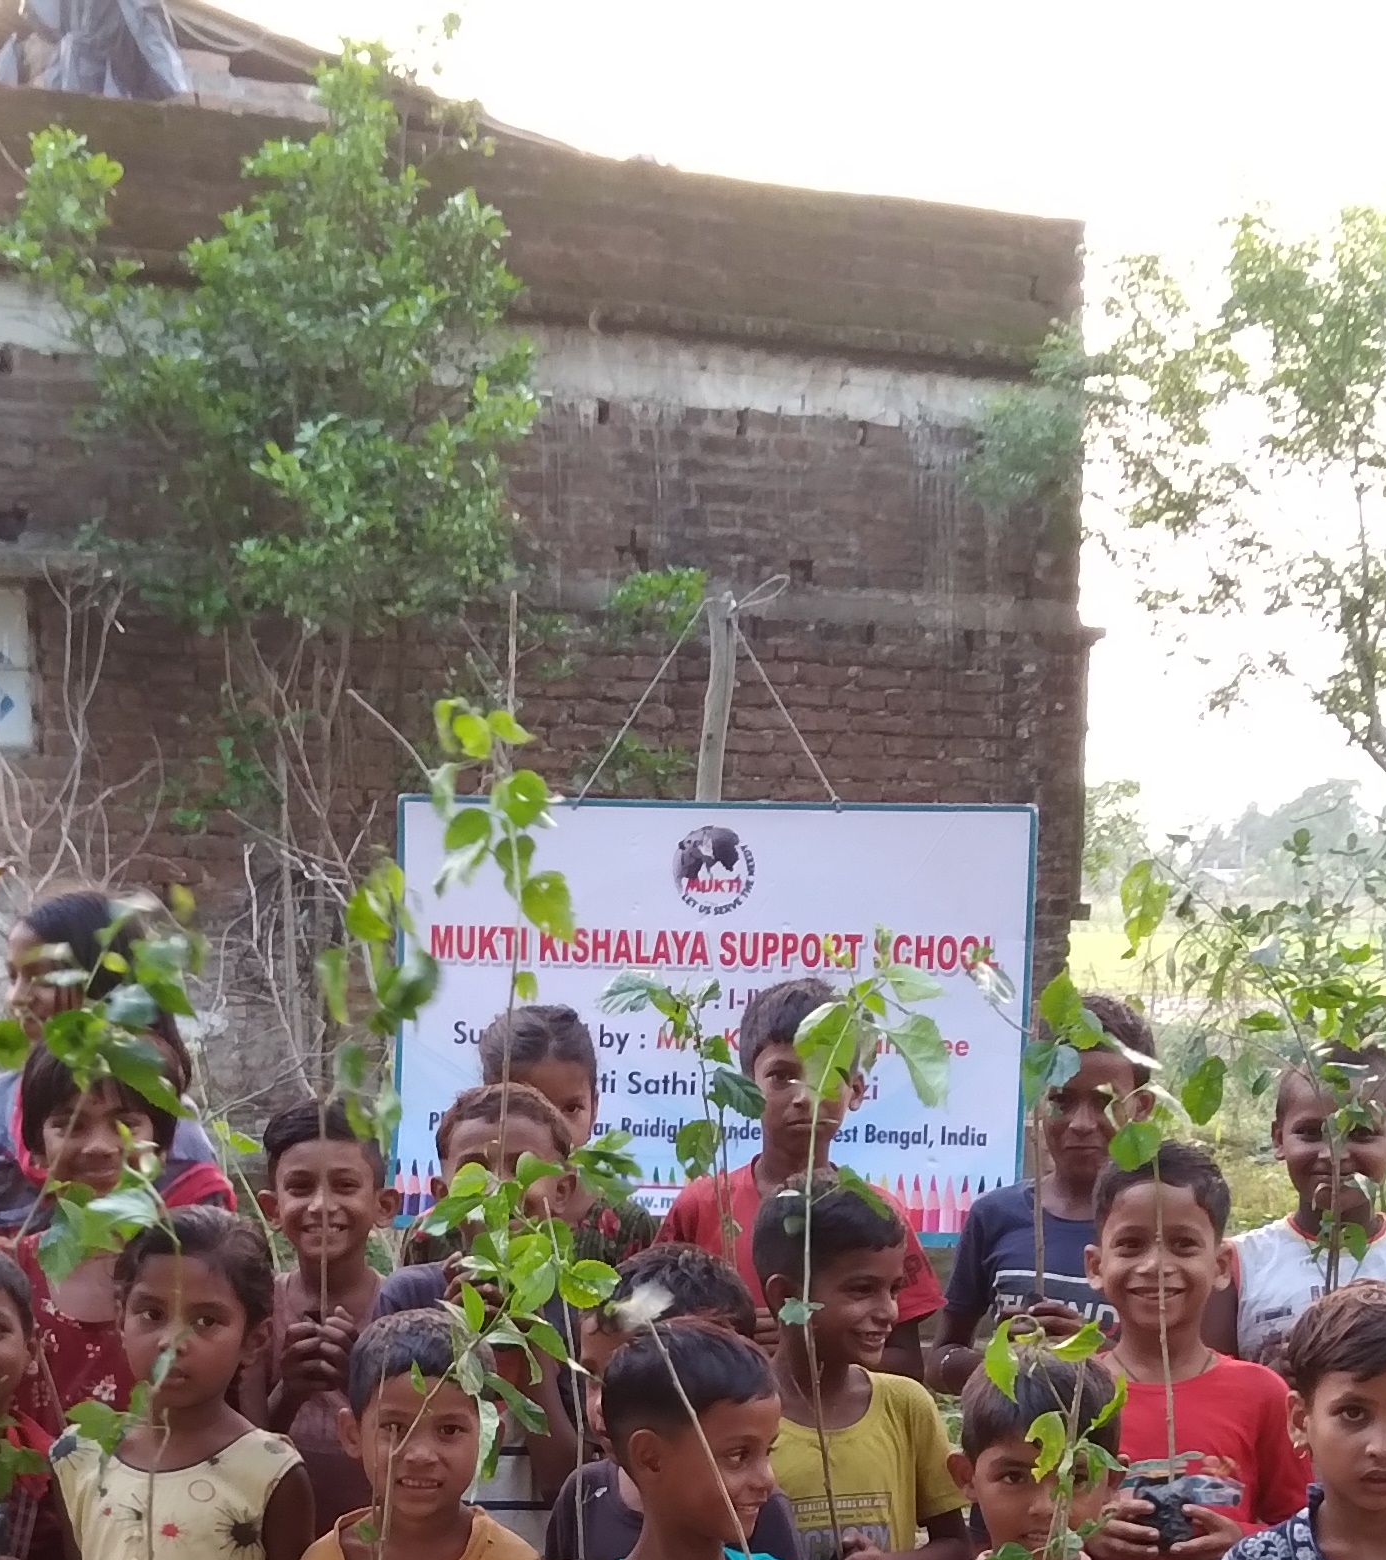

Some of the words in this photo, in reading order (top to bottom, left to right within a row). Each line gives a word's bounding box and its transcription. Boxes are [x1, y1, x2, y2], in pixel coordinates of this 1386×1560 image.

[685, 877, 741, 894] MUKTI
[430, 924, 528, 962] MUKTI
[539, 927, 709, 966] KISHALAYA
[719, 931, 864, 969] SUPPORT
[599, 1023, 630, 1055] by
[627, 1070, 697, 1096] Sathi
[832, 1125, 858, 1143] est
[864, 1123, 934, 1150] Bengal,
[940, 1124, 988, 1147] India
